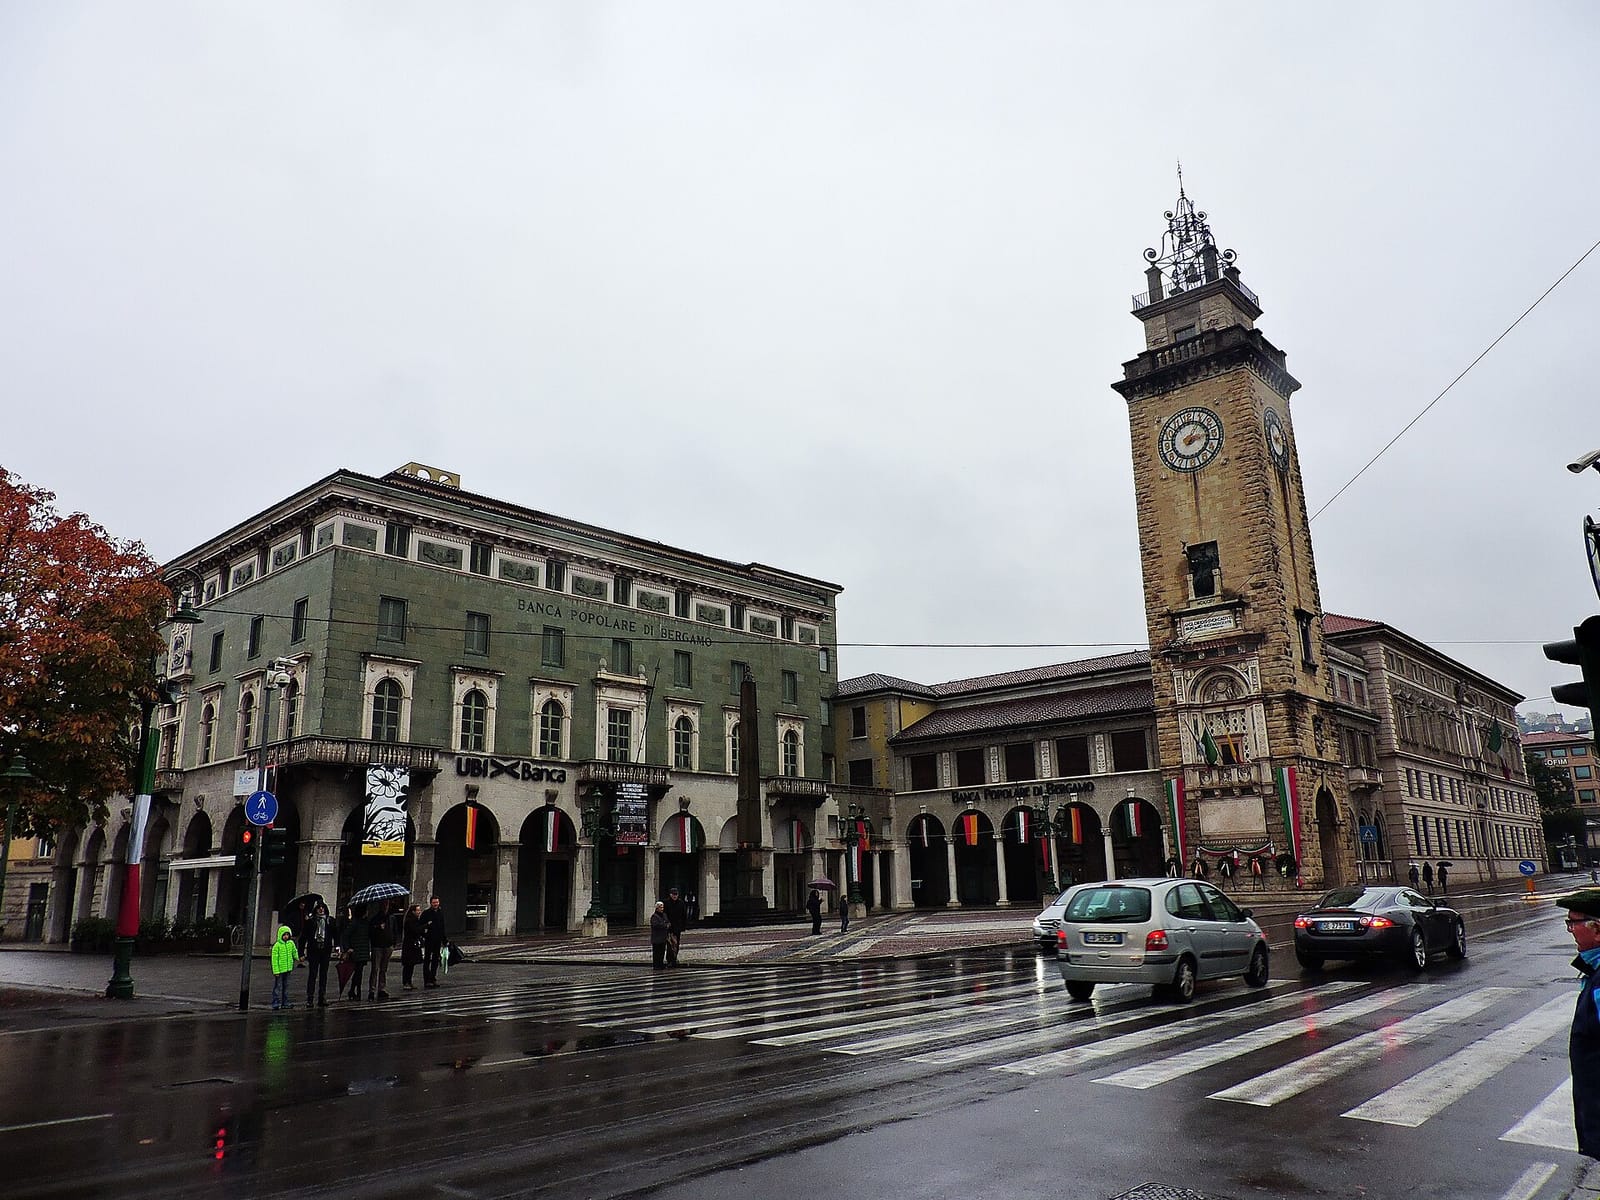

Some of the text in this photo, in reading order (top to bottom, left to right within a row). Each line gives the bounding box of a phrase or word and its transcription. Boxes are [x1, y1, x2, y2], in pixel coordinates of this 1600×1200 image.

[517, 598, 713, 647] BANCA POPOLARE DI BERGAMO
[456, 757, 567, 783] UBI Banca
[952, 781, 1095, 804] BANCA POPOLARE DI BERGAMO
